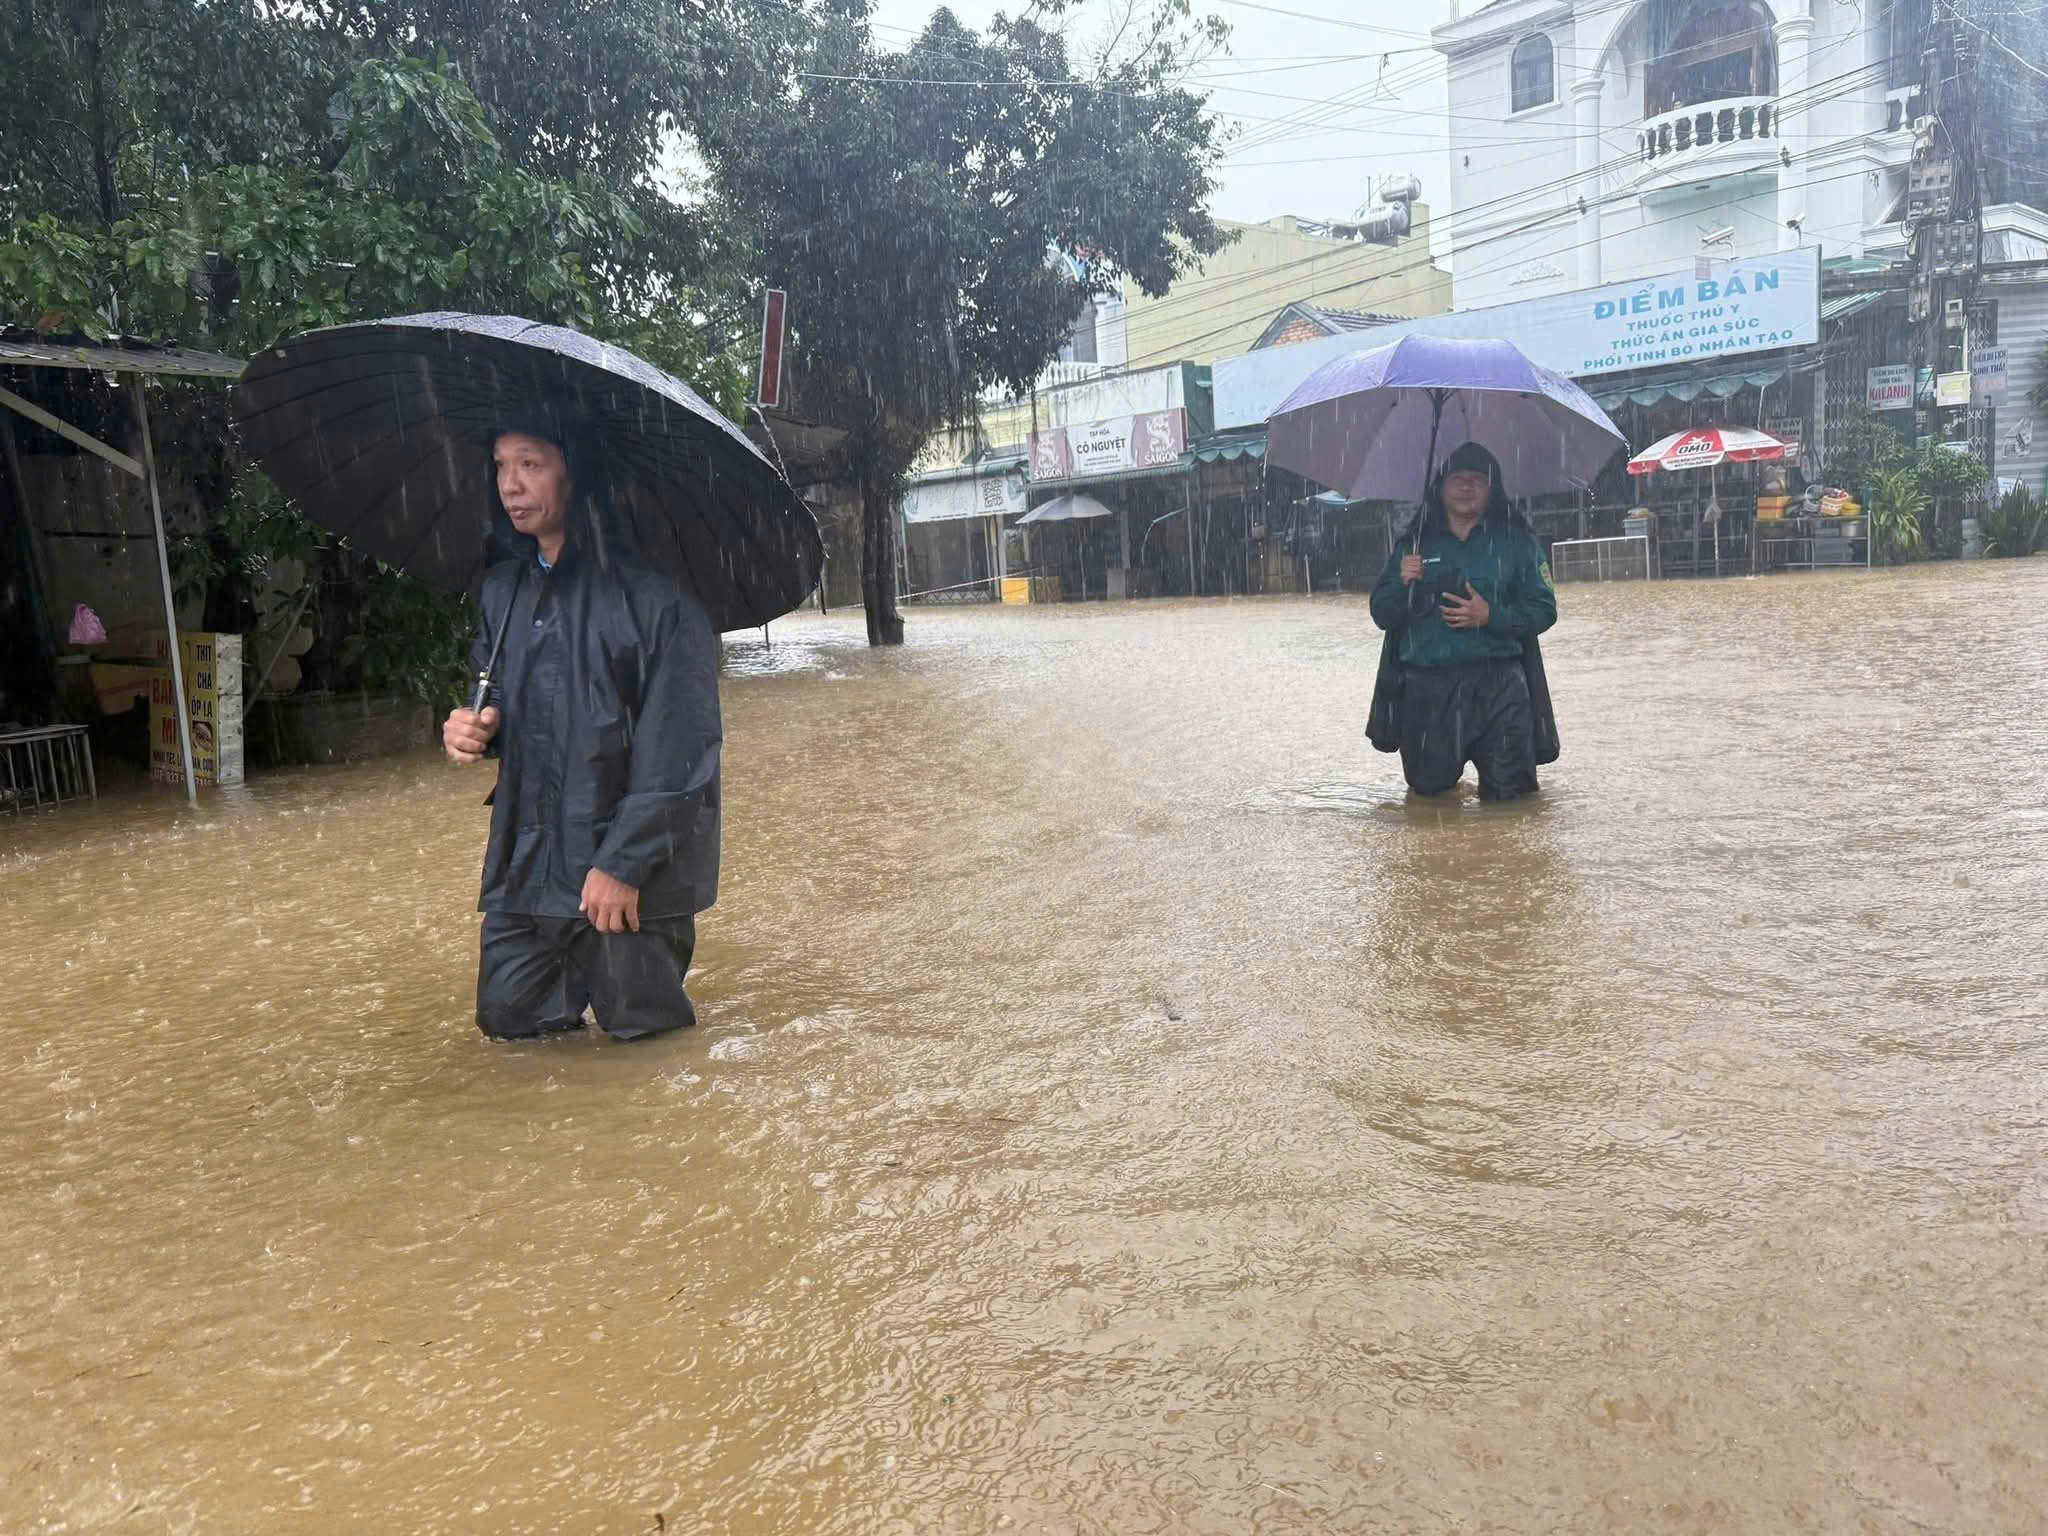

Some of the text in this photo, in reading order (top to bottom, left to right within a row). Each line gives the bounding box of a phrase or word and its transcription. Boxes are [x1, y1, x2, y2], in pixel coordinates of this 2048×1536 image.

[1594, 268, 1779, 320] ĐIỂM BÁN
[1625, 303, 1740, 331] THUỐC THÚ Y
[1610, 333, 1655, 349] THỨC
[1689, 325, 1718, 337] GIA
[1723, 316, 1760, 332] SÚC
[1626, 350, 1666, 363] TINH
[1755, 329, 1792, 345] TẠO
[1091, 436, 1127, 453] NGUYỆT
[1678, 442, 1711, 455] OMO
